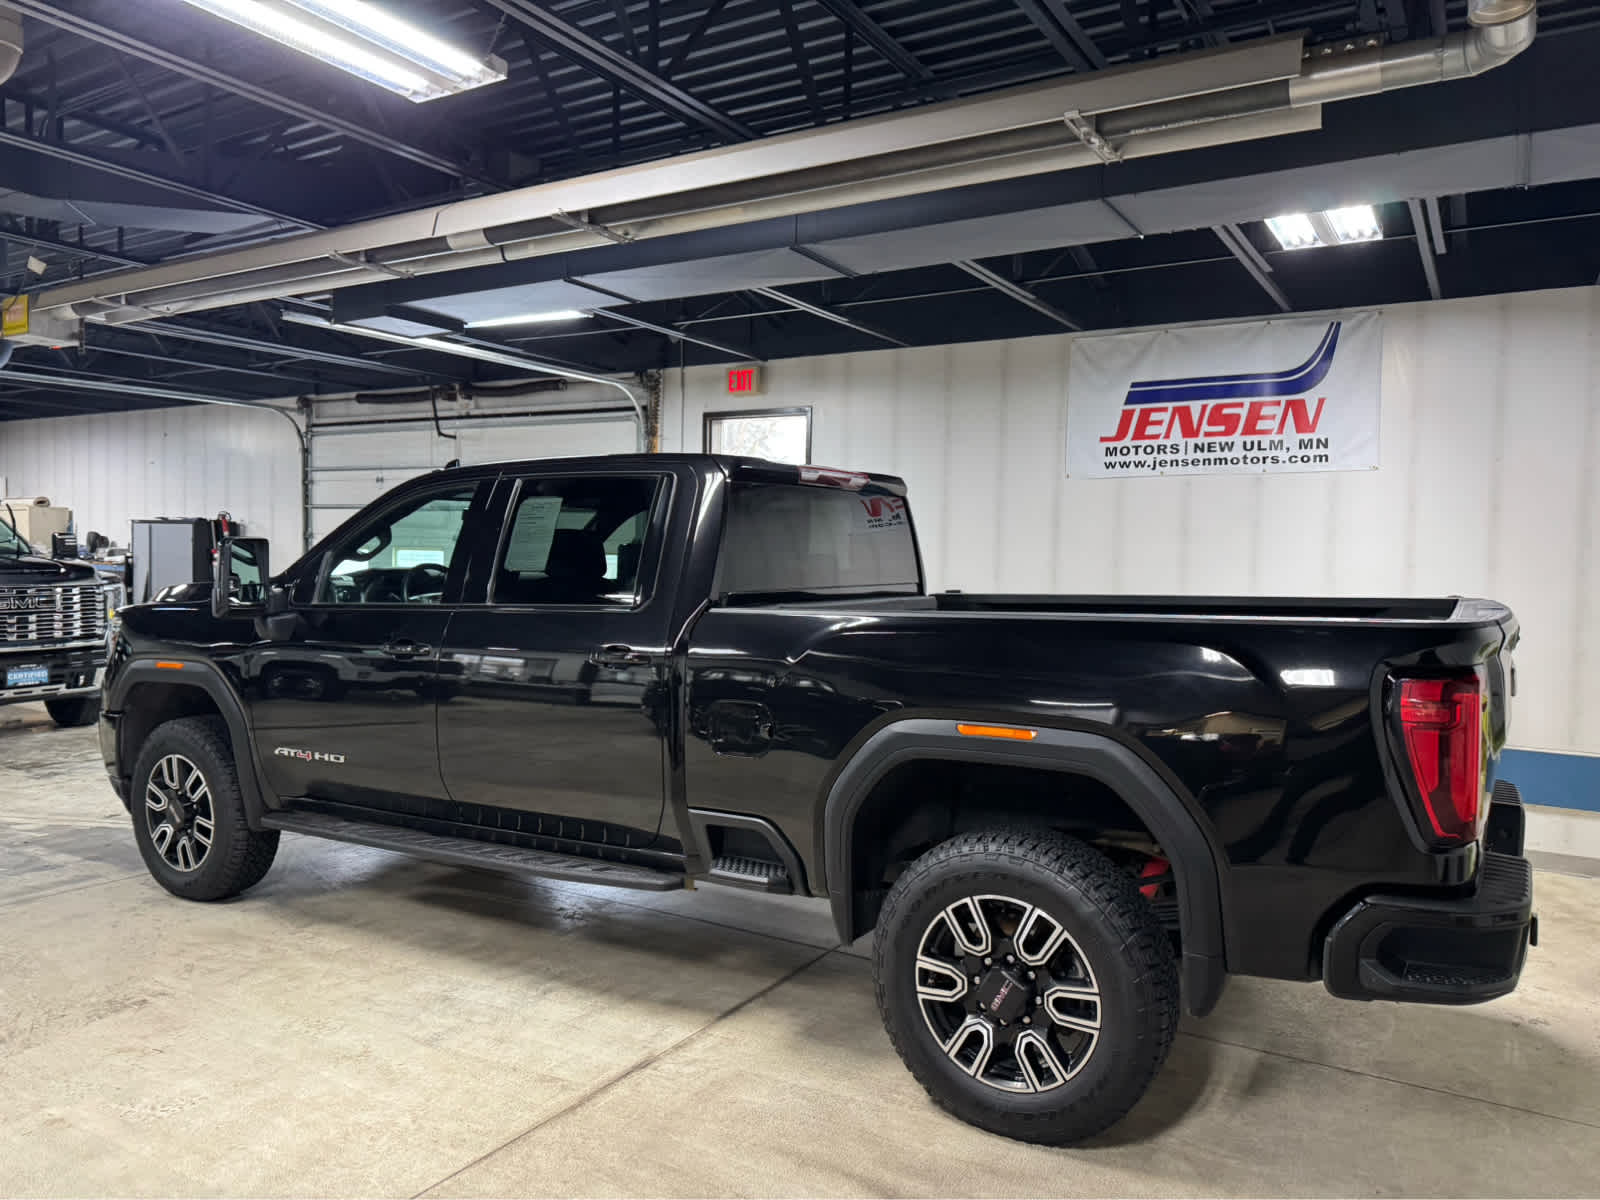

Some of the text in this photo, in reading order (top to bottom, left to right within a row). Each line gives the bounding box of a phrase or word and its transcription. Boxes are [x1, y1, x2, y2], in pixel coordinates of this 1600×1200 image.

[728, 369, 755, 393] EXIT
[1100, 397, 1327, 443] JENSEN
[1105, 437, 1329, 457] MOTORS NEW ULM, MN
[1104, 453, 1329, 471] www.jensenmotors.com
[274, 747, 345, 763] AT4 HD
